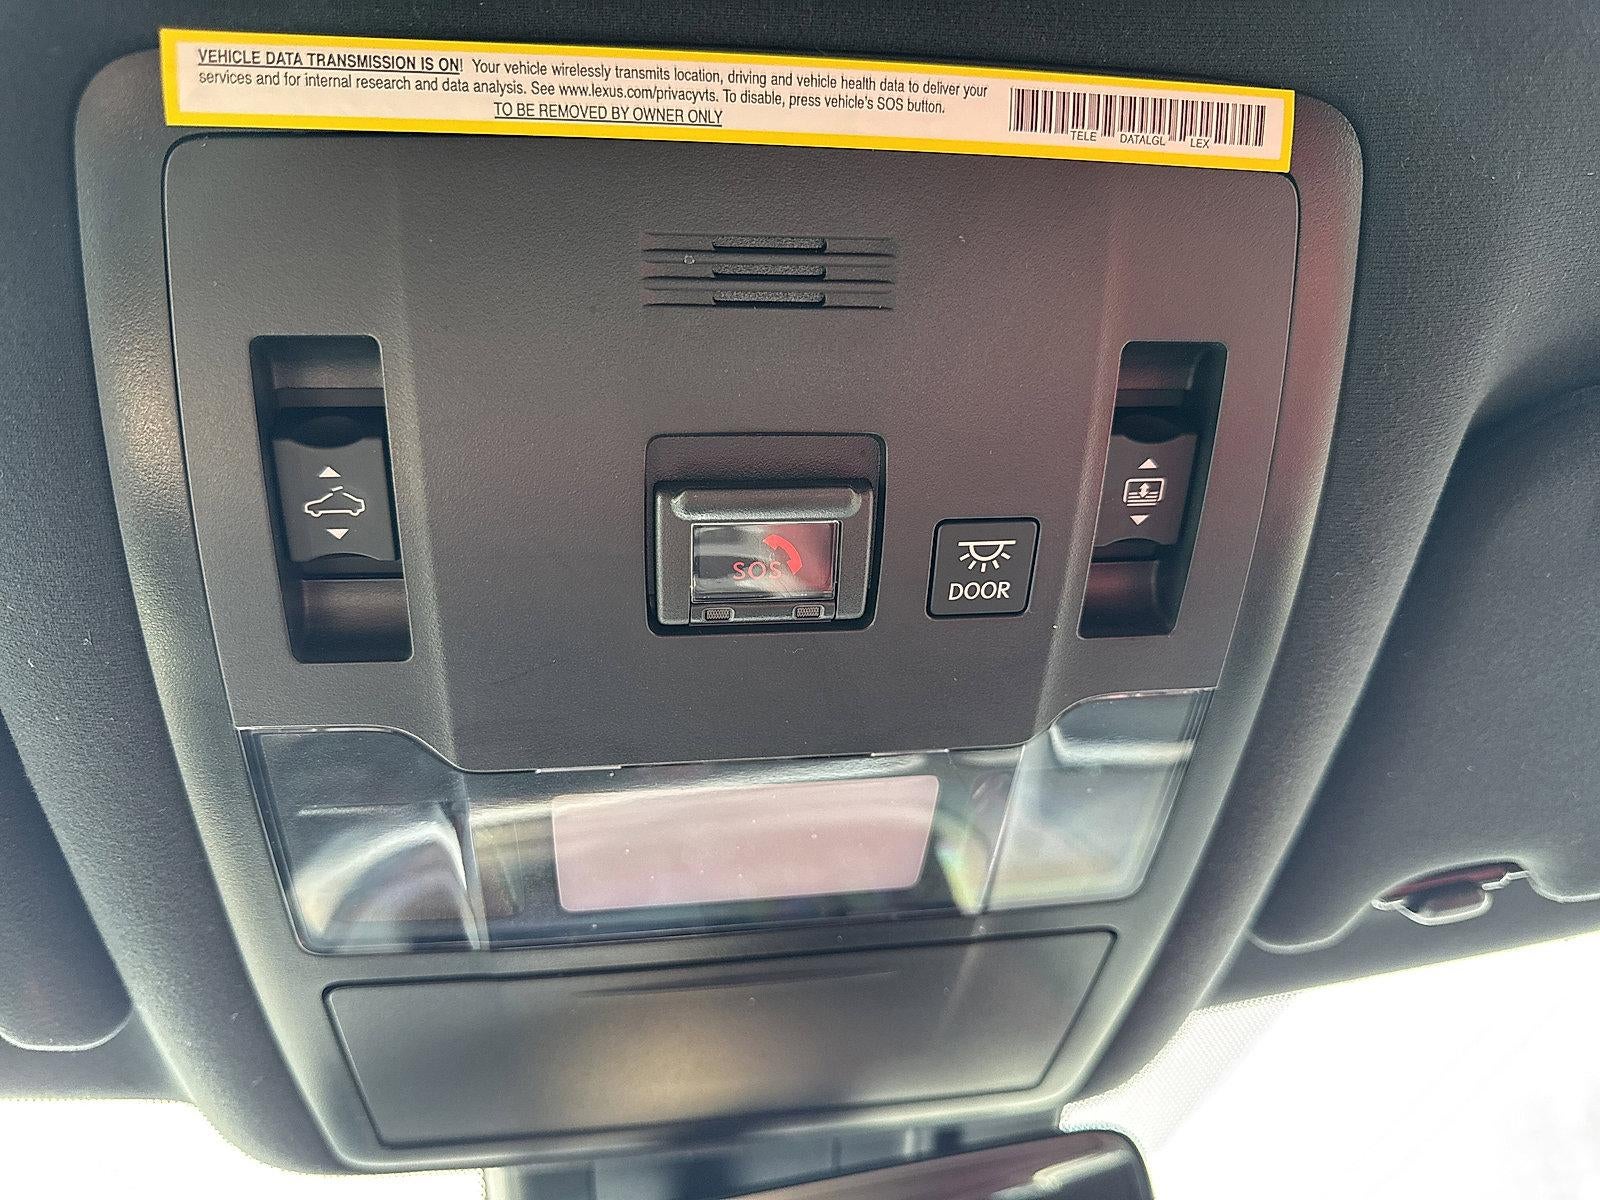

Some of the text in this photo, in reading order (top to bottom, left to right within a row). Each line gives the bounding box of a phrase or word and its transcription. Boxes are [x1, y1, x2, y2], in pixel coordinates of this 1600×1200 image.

[198, 49, 988, 100] VEHICLE DATA TRANSMISSION IS ON! Your vehicle wirelessly transmits location, driving and vehicle health data to deliver your
[199, 70, 946, 114] services and for internal research and data analysis. See www.lexus.com/privacyvts. To disable, press vehicle's SOS button.
[495, 102, 722, 124] TO BE REMOVED BY OWNER ONLY
[1070, 130, 1210, 149] TELE DATALGL LEX
[732, 561, 782, 580] SOS
[949, 581, 1011, 601] DOOR
